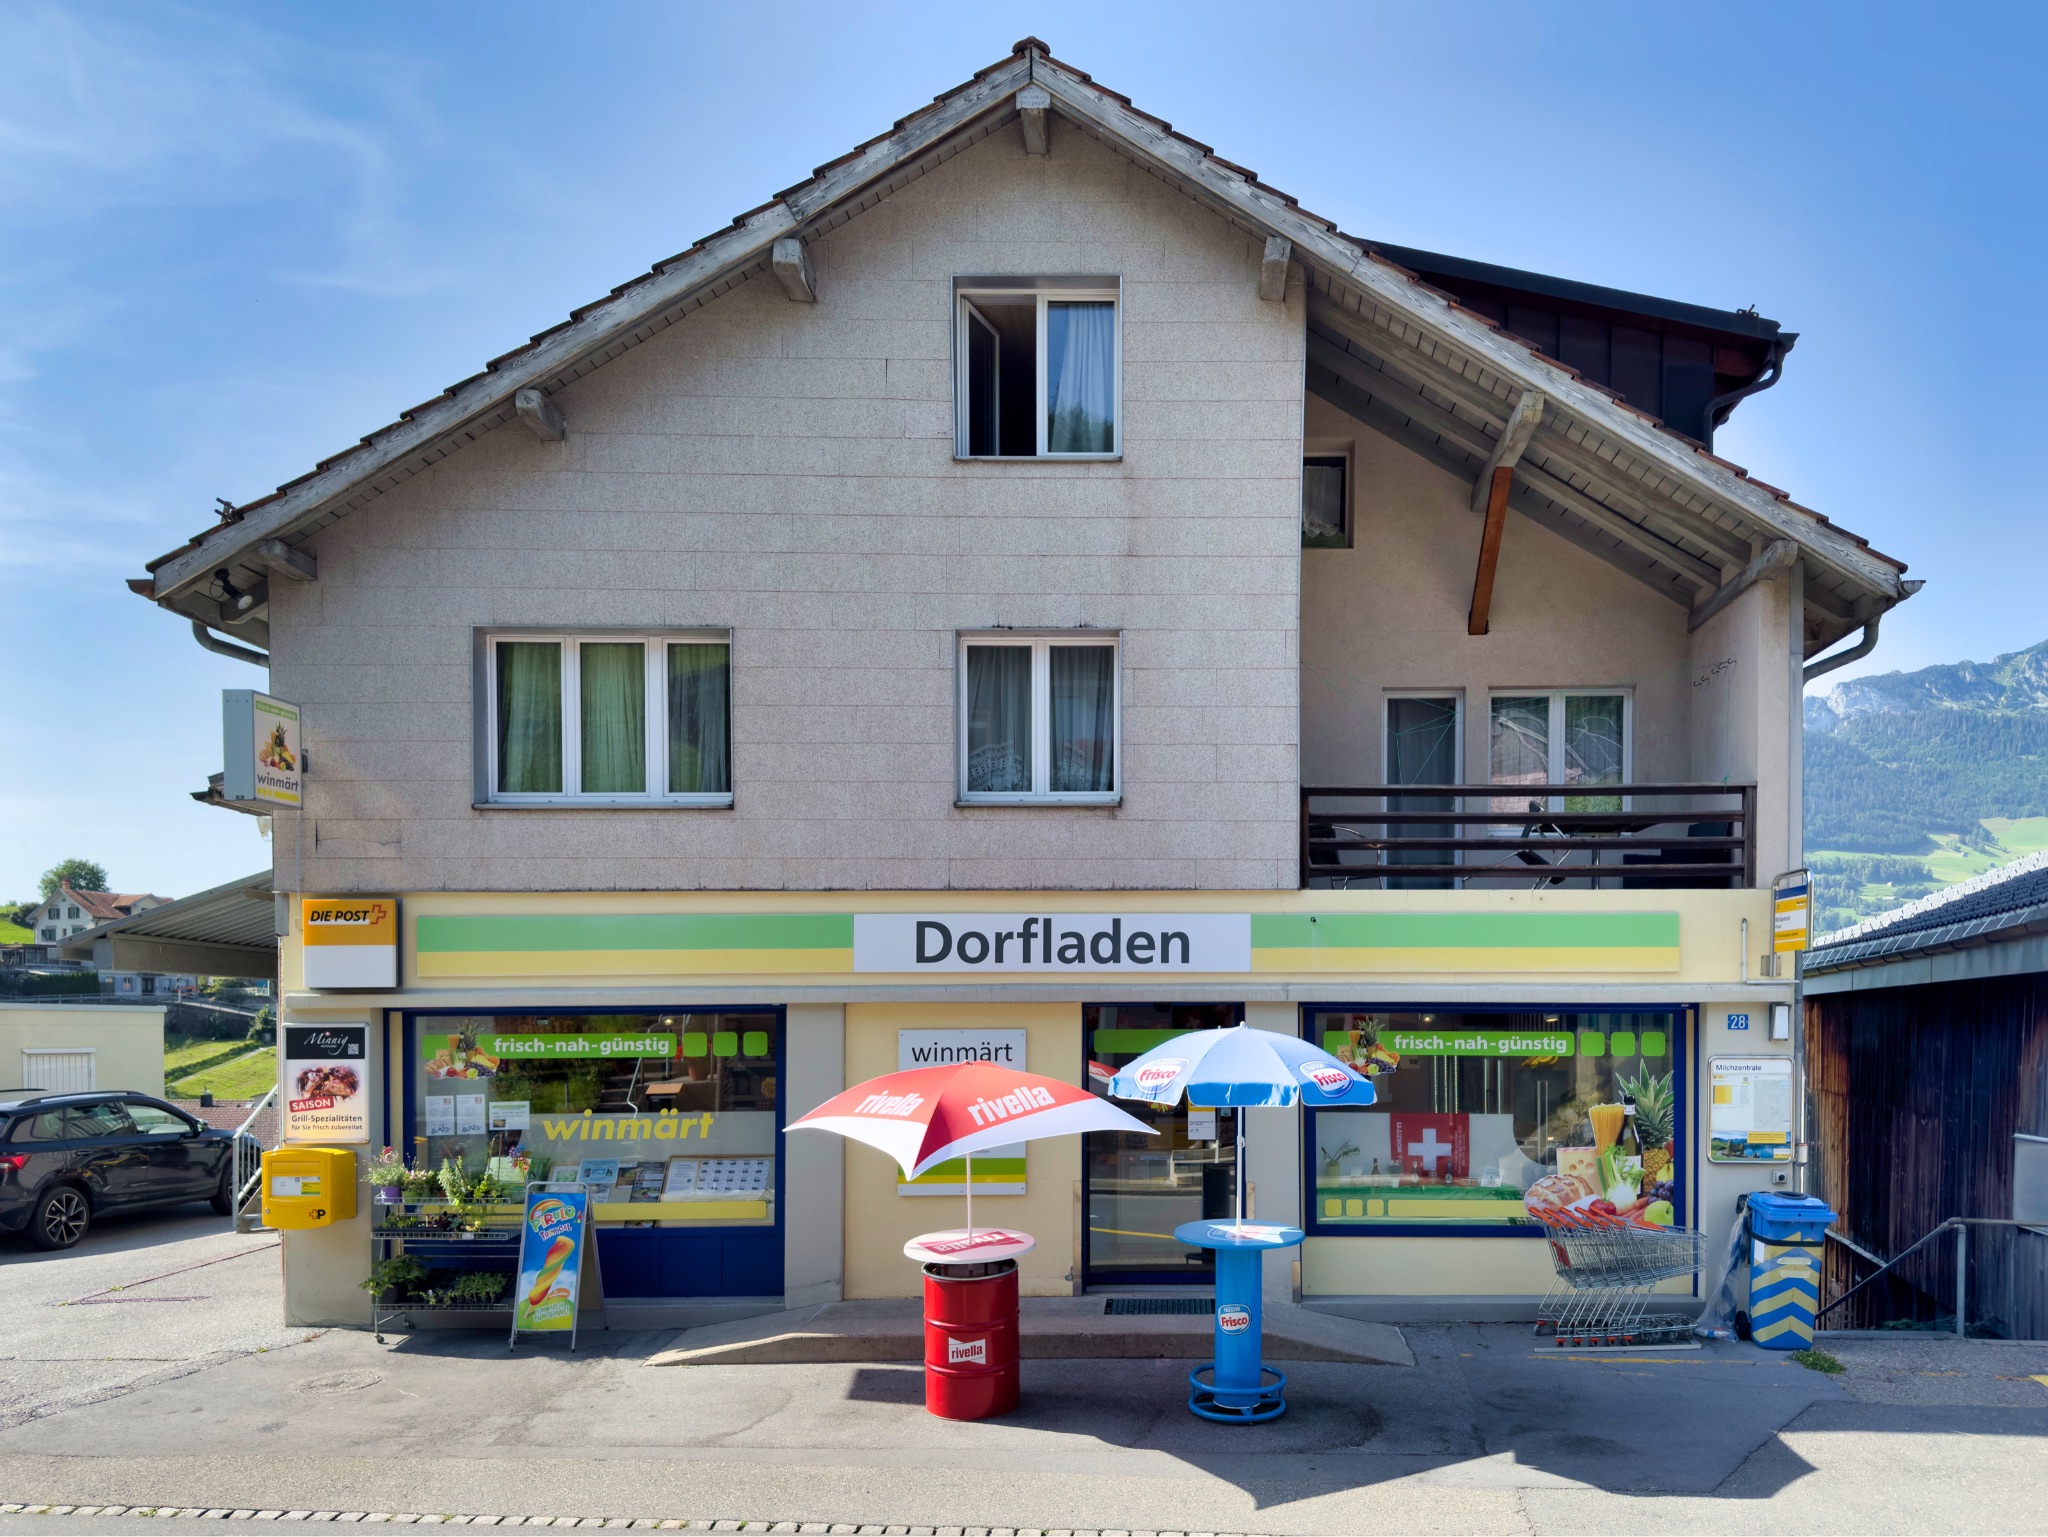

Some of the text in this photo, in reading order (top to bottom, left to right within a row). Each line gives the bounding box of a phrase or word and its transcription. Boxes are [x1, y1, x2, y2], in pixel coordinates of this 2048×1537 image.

[257, 773, 299, 792] winmärt
[310, 910, 370, 922] DIE POST
[916, 917, 1190, 964] Dorfladen
[1730, 1015, 1746, 1029] 28
[304, 1031, 349, 1055] Minnig
[494, 1037, 669, 1055] frisch-nah-günstig
[1394, 1035, 1567, 1053] frisch-nah-günstig
[912, 1041, 1013, 1062] winmärt
[1139, 1068, 1176, 1081] Frisco
[1715, 1064, 1762, 1072] Milchzentrale
[1313, 1073, 1347, 1087] Frisco
[292, 1098, 331, 1111] SAISON
[853, 1090, 924, 1117] rivella
[967, 1086, 1056, 1126] rivella
[292, 1115, 362, 1123] Grill-Spezialitäten
[543, 1108, 714, 1141] winmärt
[1221, 1316, 1248, 1327] Frisco
[951, 1344, 983, 1359] rivella
